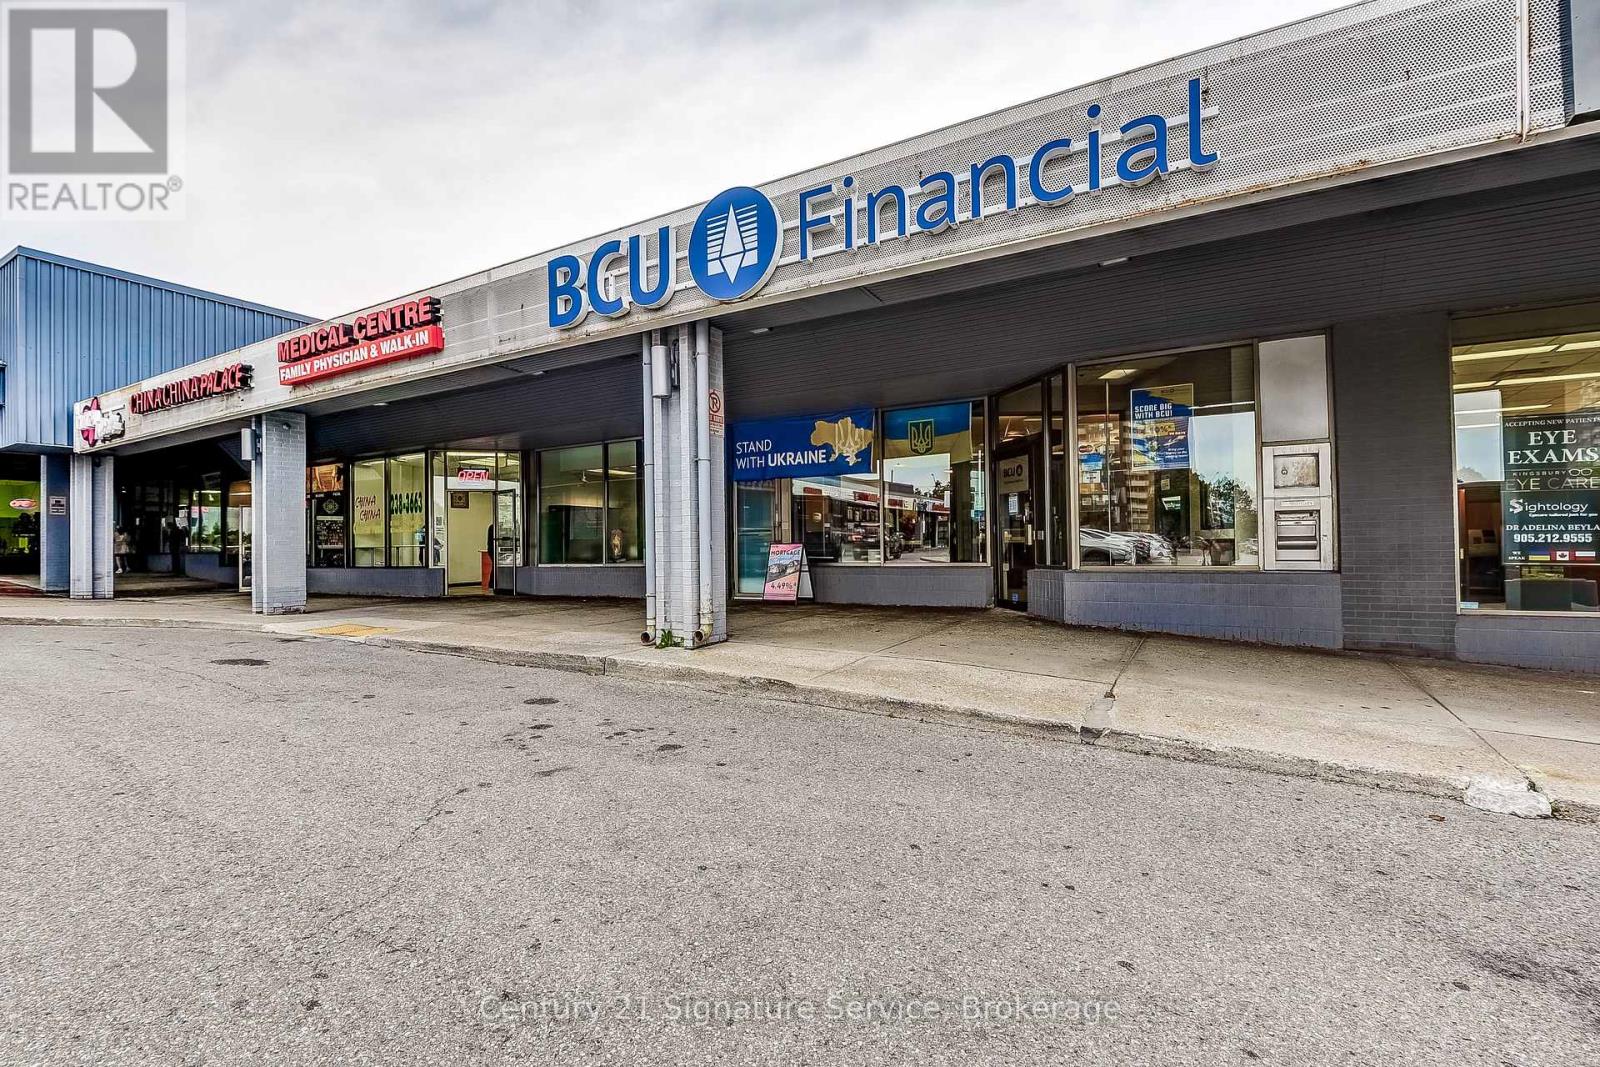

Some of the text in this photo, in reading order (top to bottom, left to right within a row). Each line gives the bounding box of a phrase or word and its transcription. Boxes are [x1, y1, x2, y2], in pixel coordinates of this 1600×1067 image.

[548, 76, 1220, 329] BCU Financial
[278, 296, 432, 362] MEDICAL CENTRE
[280, 330, 430, 381] FAMILY PHYSICIAN & WALK-IN
[131, 363, 243, 414] CHINA CHINA PALACE
[1134, 402, 1173, 413] SCORE BIG
[1134, 411, 1154, 419] WITH
[1528, 429, 1577, 446] EYE
[736, 439, 772, 455] STAND
[736, 449, 827, 470] WITH UKRAINE
[1507, 447, 1600, 465] EXAMS
[458, 470, 489, 482] OPEN
[1505, 477, 1600, 490] EYE CARE
[1509, 498, 1589, 514] Sightology
[1513, 533, 1593, 543] 905.212.9555
